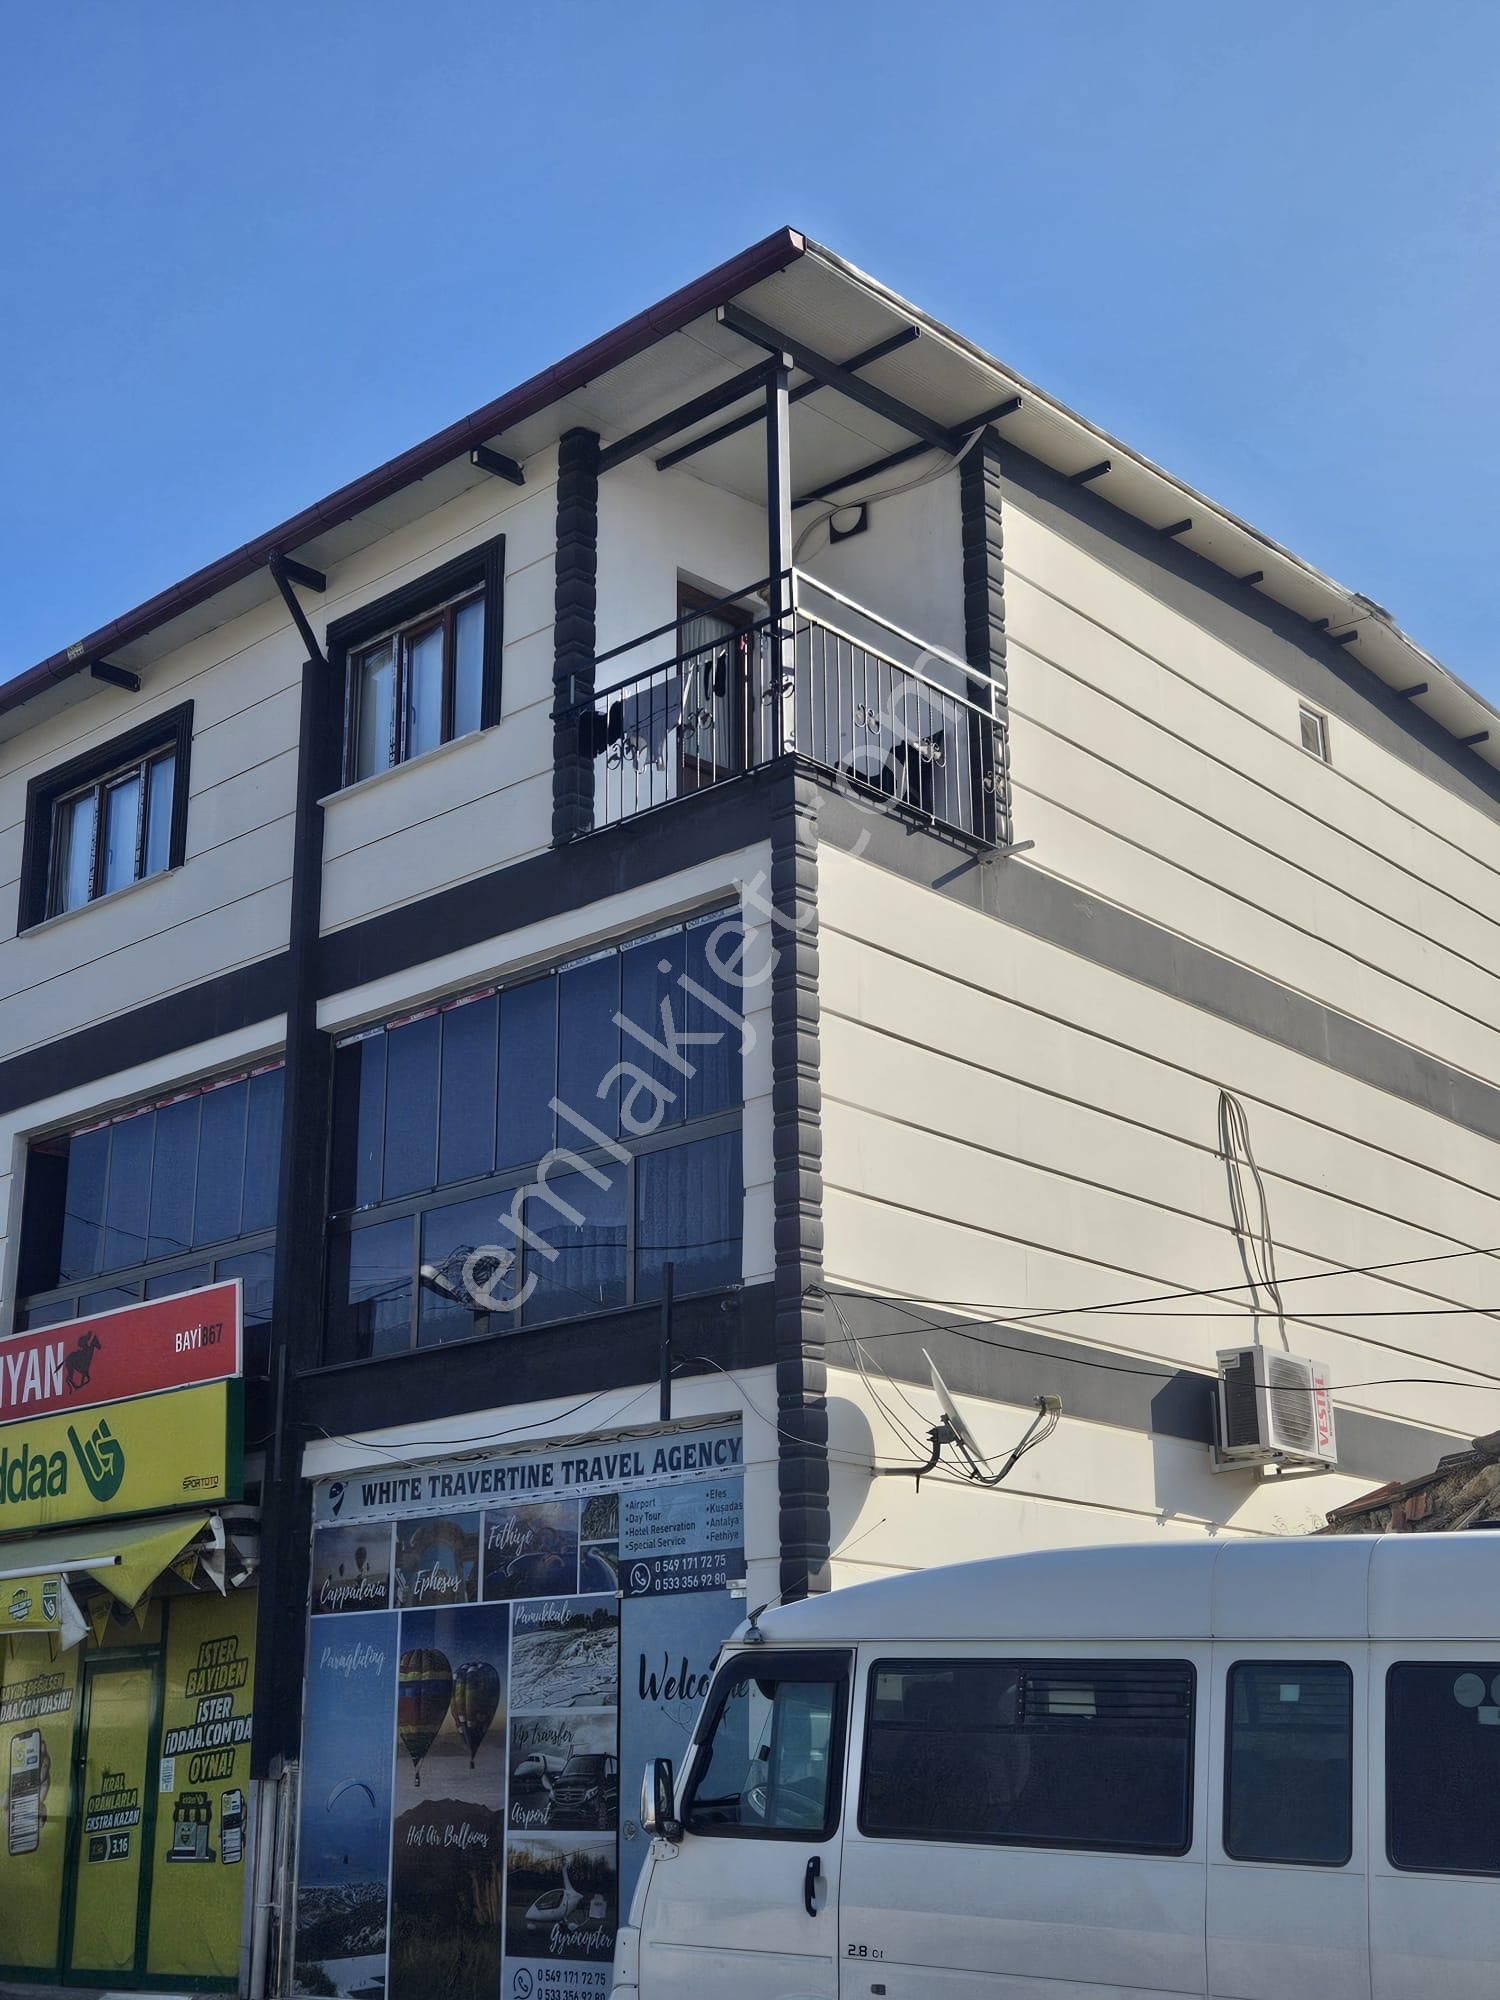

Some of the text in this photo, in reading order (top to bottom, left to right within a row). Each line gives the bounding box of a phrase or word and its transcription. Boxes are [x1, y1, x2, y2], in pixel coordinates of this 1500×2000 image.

[0, 1342, 64, 1408] YAN
[362, 1436, 742, 1506] WHITE TRAVERTINE TRAVEL AGENCY
[629, 1498, 656, 1512] Airport
[629, 1511, 662, 1525] Day Tour
[710, 1516, 740, 1529] Antalya
[487, 1514, 535, 1556] Fethiye
[629, 1521, 696, 1538] Hotel Reservation
[710, 1530, 739, 1542] Fethiye
[628, 1536, 687, 1554] Special Service
[655, 1554, 726, 1573] 0 549 171 72 75
[320, 1564, 388, 1609] Cappadocia
[413, 1560, 462, 1600] Ephesus
[655, 1572, 726, 1591] 0 533 356 92 80
[638, 1650, 750, 1702] Welcoe
[102, 1775, 127, 1792] KRAL
[511, 1801, 552, 1830] Airport
[406, 1822, 489, 1850] Hot Air Balloons
[549, 1923, 614, 1955] Gyrocopter
[848, 1944, 868, 1957] 2.8
[537, 1969, 606, 1986] 0 549 171 72 75
